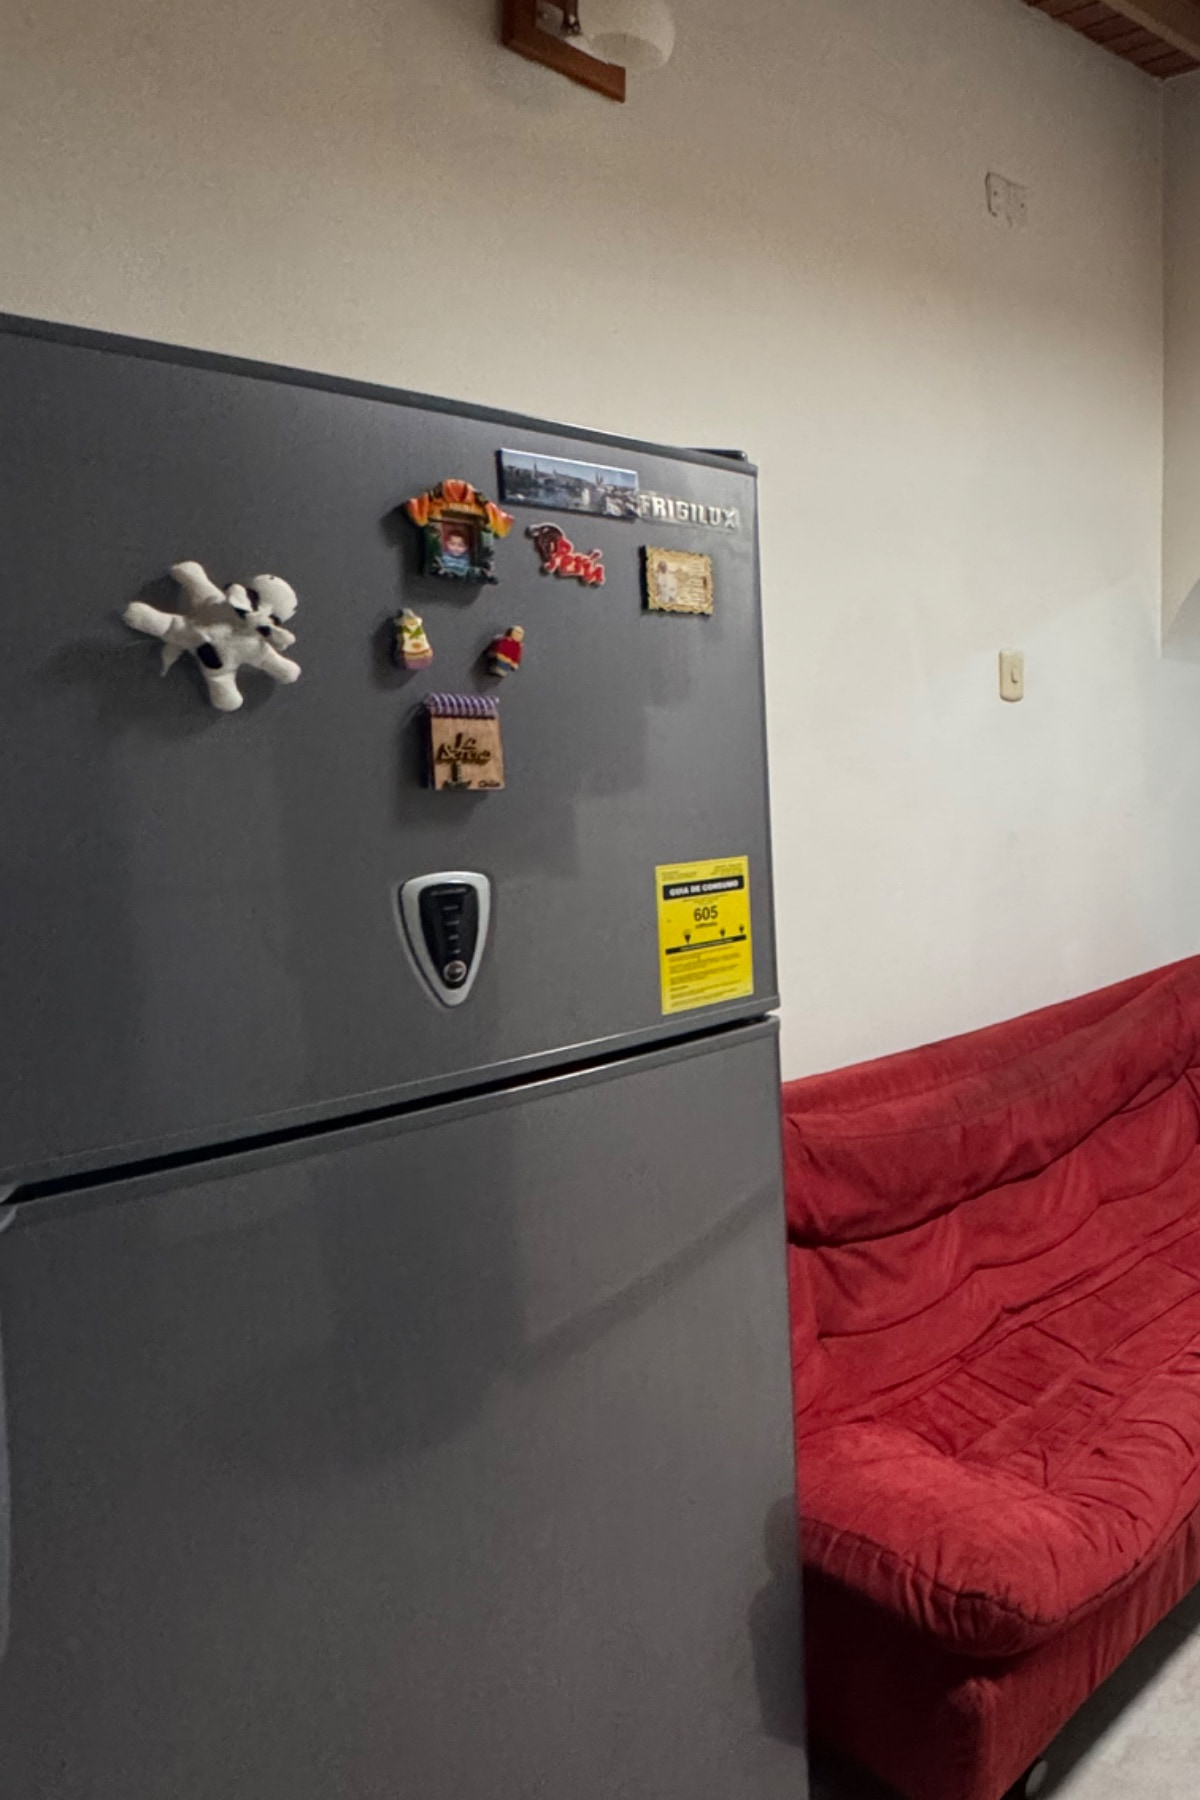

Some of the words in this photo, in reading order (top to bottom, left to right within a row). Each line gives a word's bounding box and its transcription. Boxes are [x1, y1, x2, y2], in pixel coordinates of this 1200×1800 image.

[639, 494, 736, 528] FRIGILUX
[690, 884, 701, 893] DE
[702, 879, 739, 892] CONSUMO
[694, 905, 718, 922] 605
